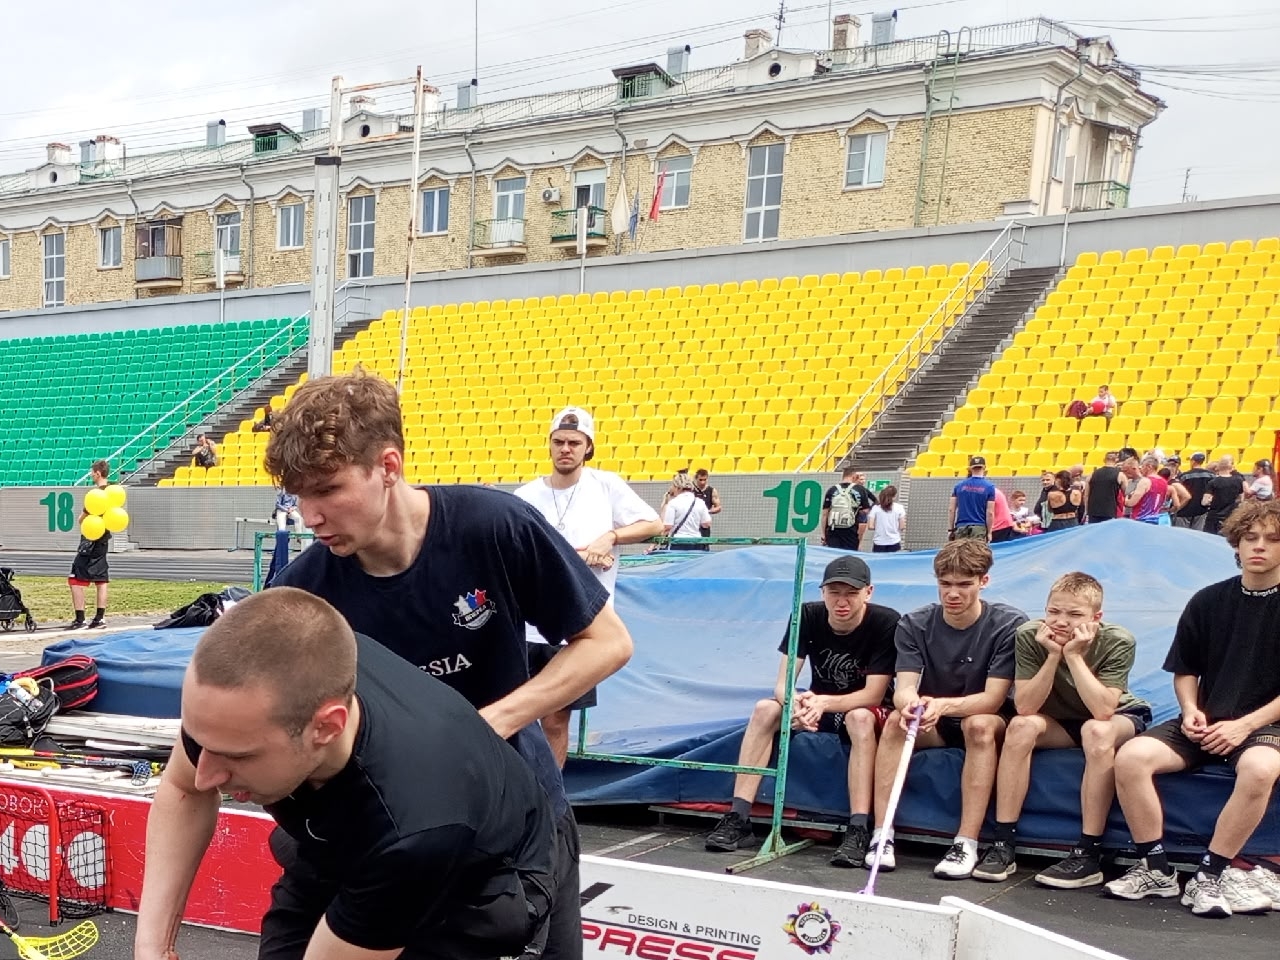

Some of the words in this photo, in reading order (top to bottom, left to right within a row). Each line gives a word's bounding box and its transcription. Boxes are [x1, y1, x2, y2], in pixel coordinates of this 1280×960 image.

[40, 491, 74, 532] 18
[763, 480, 821, 533] 19
[627, 913, 678, 932] DESIGN
[682, 923, 692, 933] &
[695, 925, 762, 946] PRINTING
